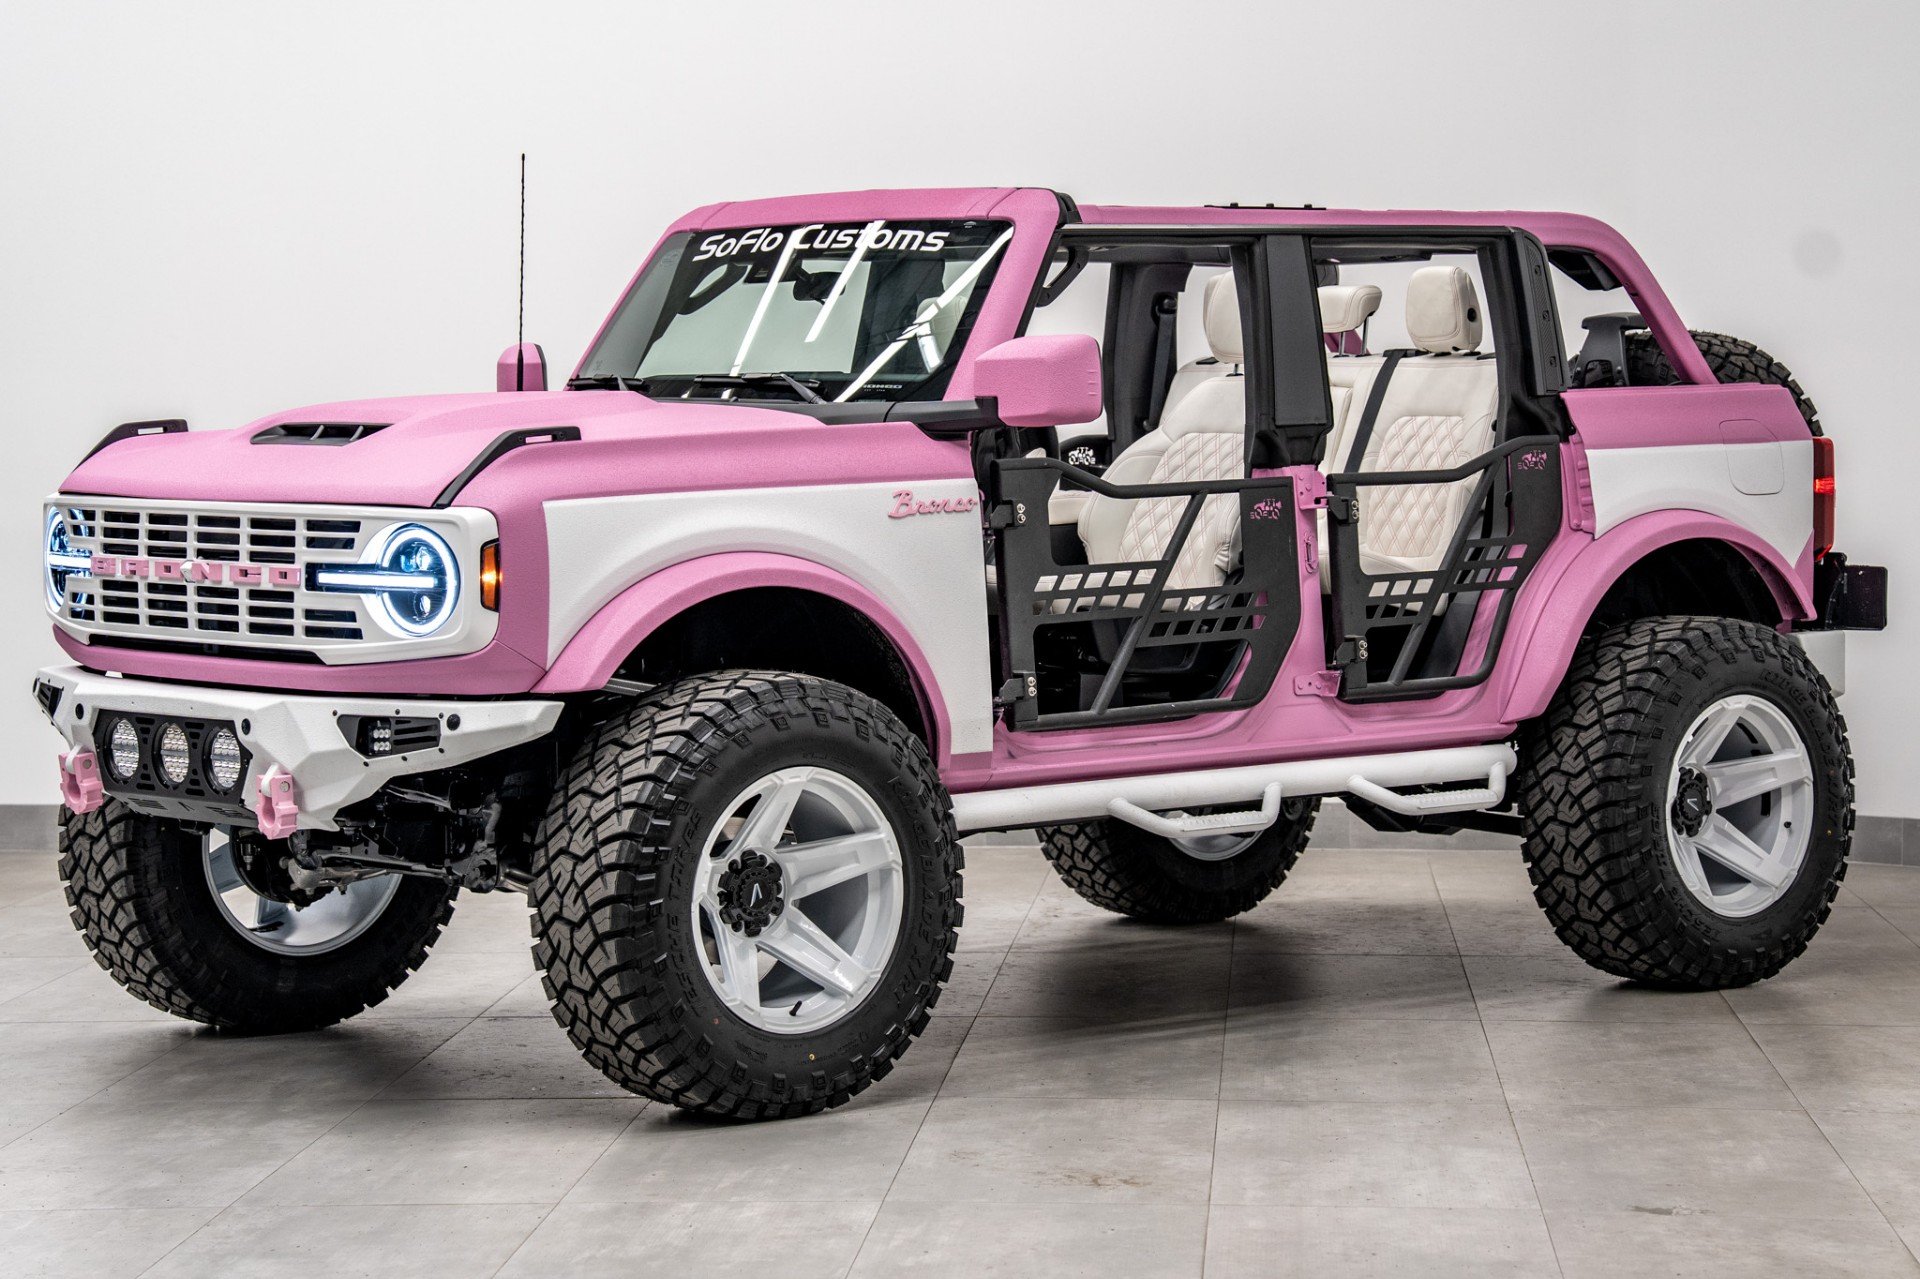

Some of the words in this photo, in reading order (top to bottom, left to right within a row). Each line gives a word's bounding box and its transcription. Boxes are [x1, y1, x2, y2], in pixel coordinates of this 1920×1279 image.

[692, 228, 784, 262] SoFlo
[793, 222, 950, 252] Customs
[888, 489, 978, 519] Bronco
[91, 556, 301, 588] BRONCO
